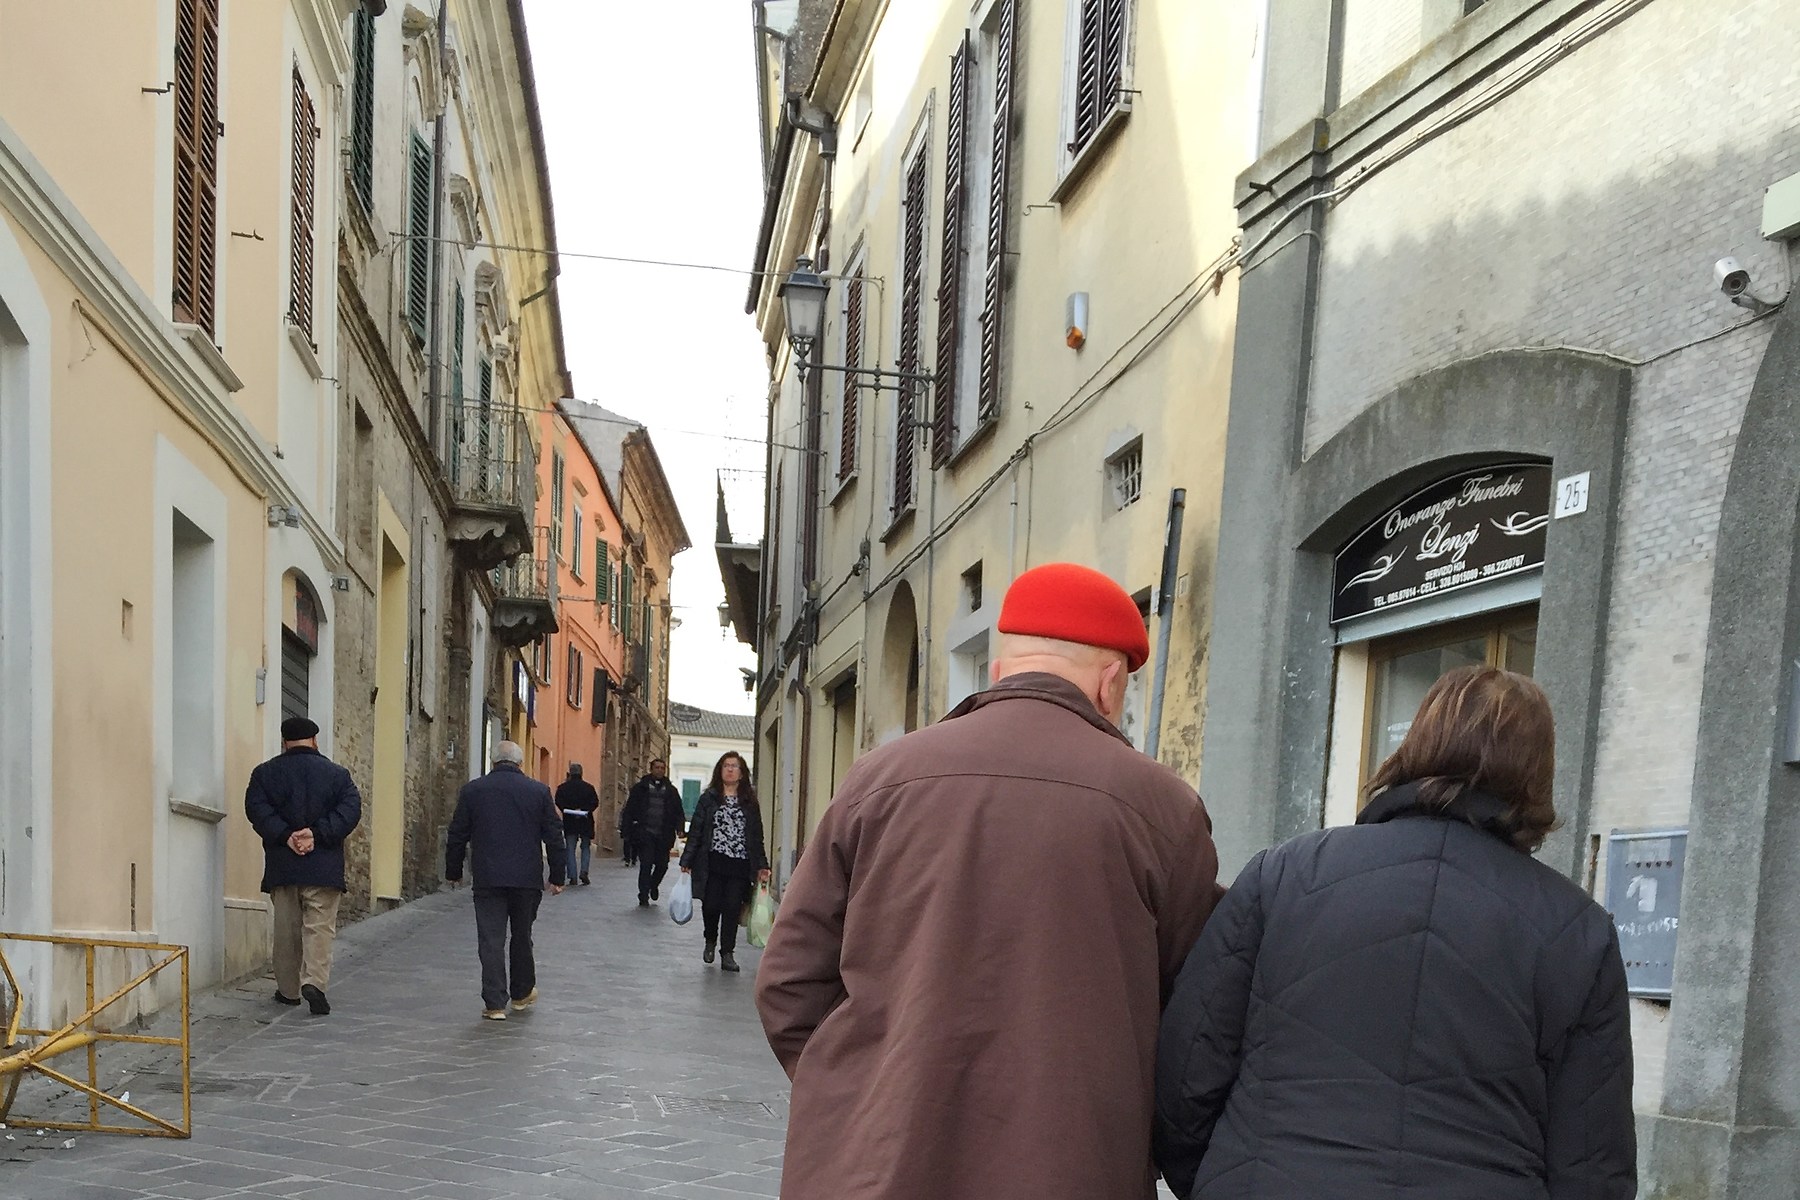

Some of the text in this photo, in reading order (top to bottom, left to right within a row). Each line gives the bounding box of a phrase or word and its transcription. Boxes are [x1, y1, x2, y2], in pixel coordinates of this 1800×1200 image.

[1384, 474, 1525, 540] Onoranze Funebri
[1564, 480, 1580, 510] 25
[1415, 522, 1481, 562] Lenzi
